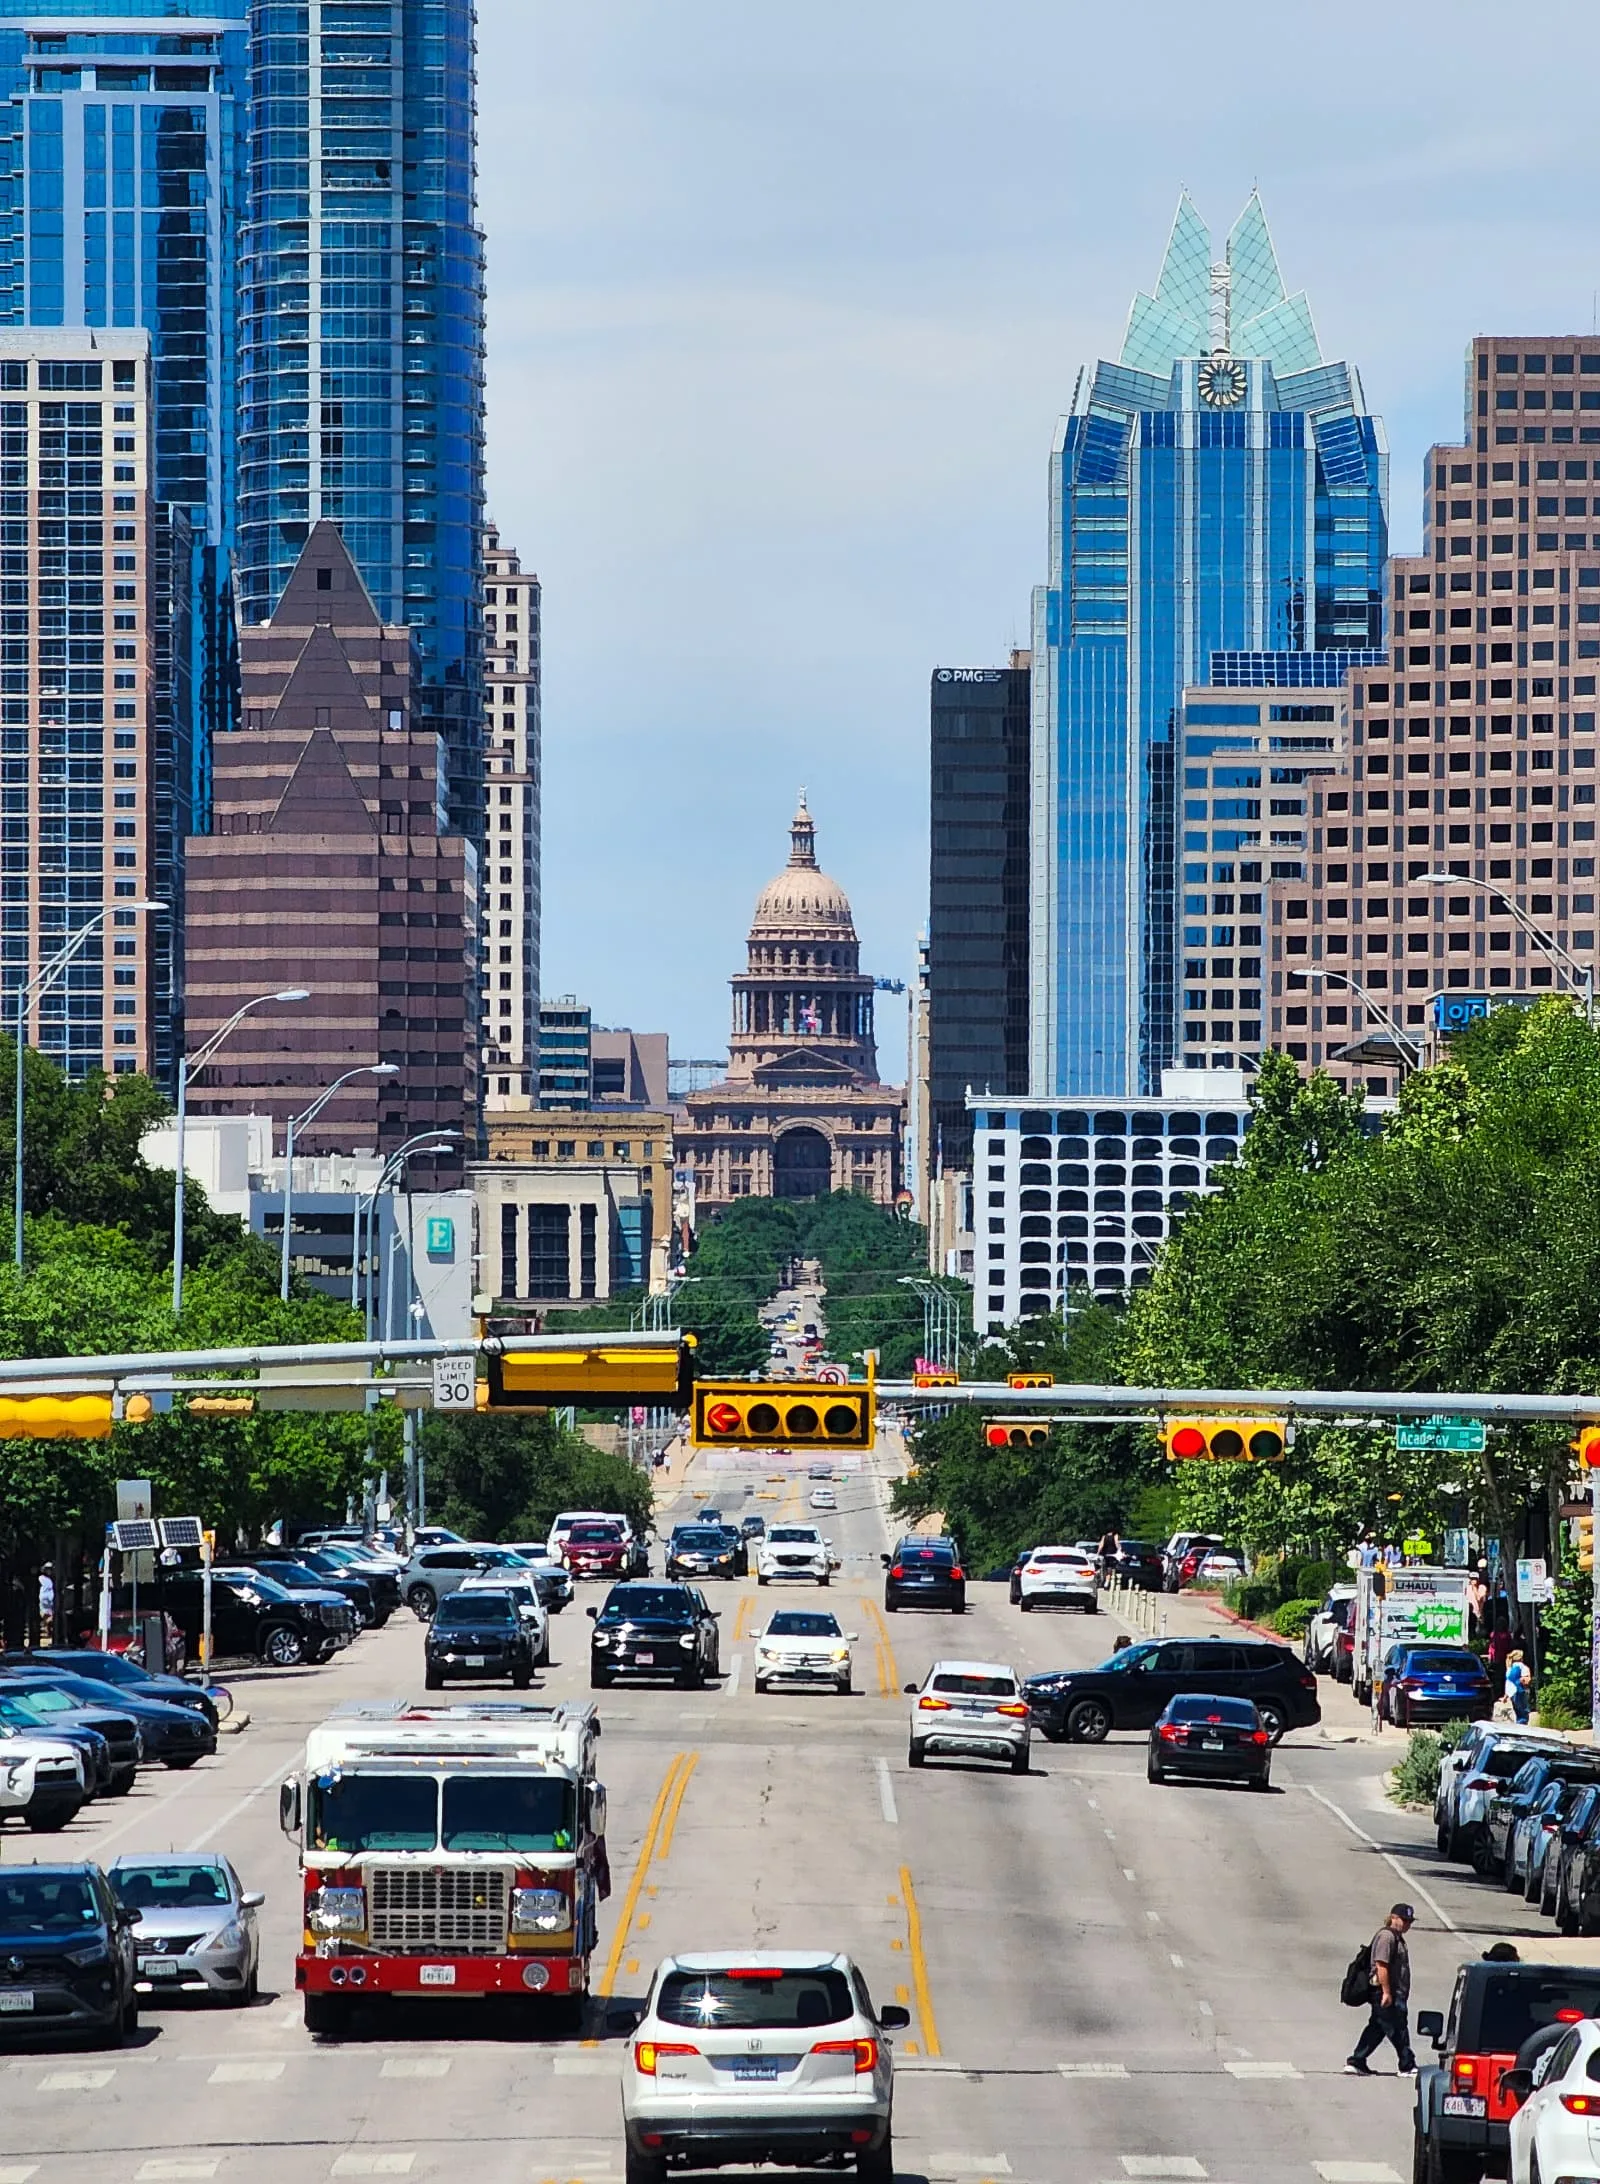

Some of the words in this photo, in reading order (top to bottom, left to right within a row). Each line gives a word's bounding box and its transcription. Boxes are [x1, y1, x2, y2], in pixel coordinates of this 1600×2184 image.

[953, 670, 983, 682] PMG
[432, 1221, 448, 1247] E
[436, 1361, 471, 1370] SPEED
[440, 1372, 467, 1381] LIMIT
[439, 1383, 470, 1402] 30
[1395, 1580, 1437, 1591] U-HAUL
